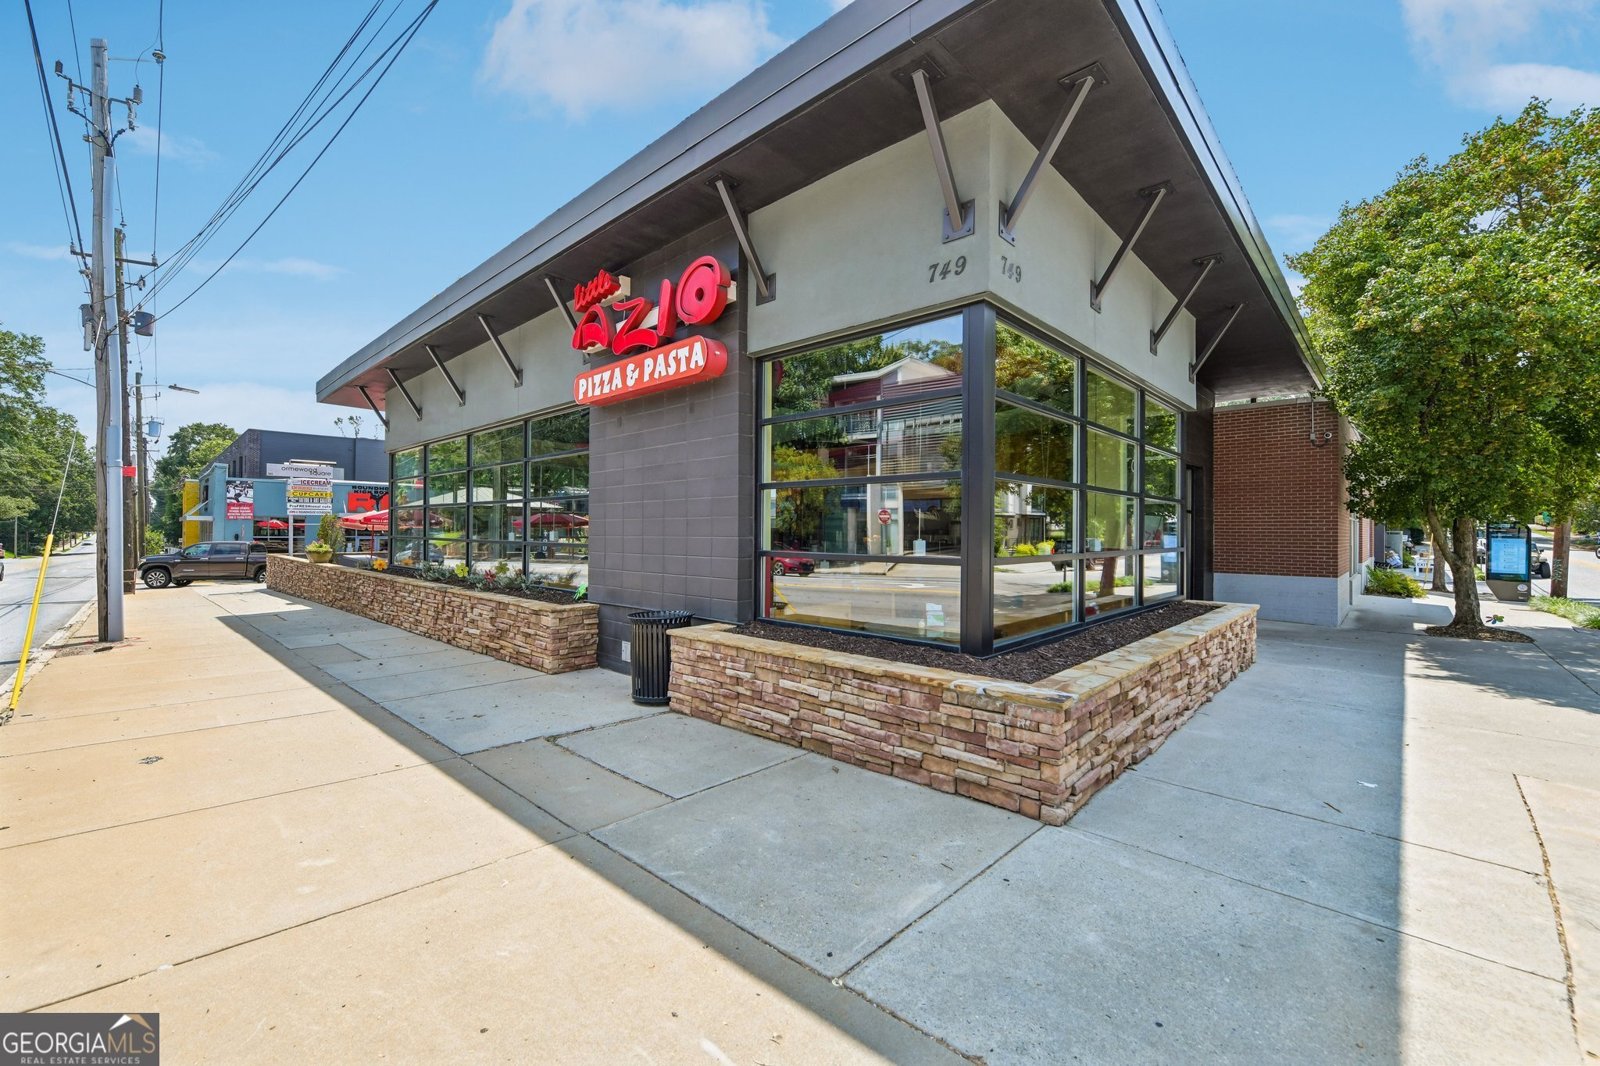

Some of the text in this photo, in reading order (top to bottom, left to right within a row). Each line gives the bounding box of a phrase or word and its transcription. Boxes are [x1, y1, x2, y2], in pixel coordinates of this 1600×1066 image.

[928, 255, 967, 283] 749
[1001, 255, 1022, 283] 749
[578, 341, 704, 400] PIZZA & PASTA
